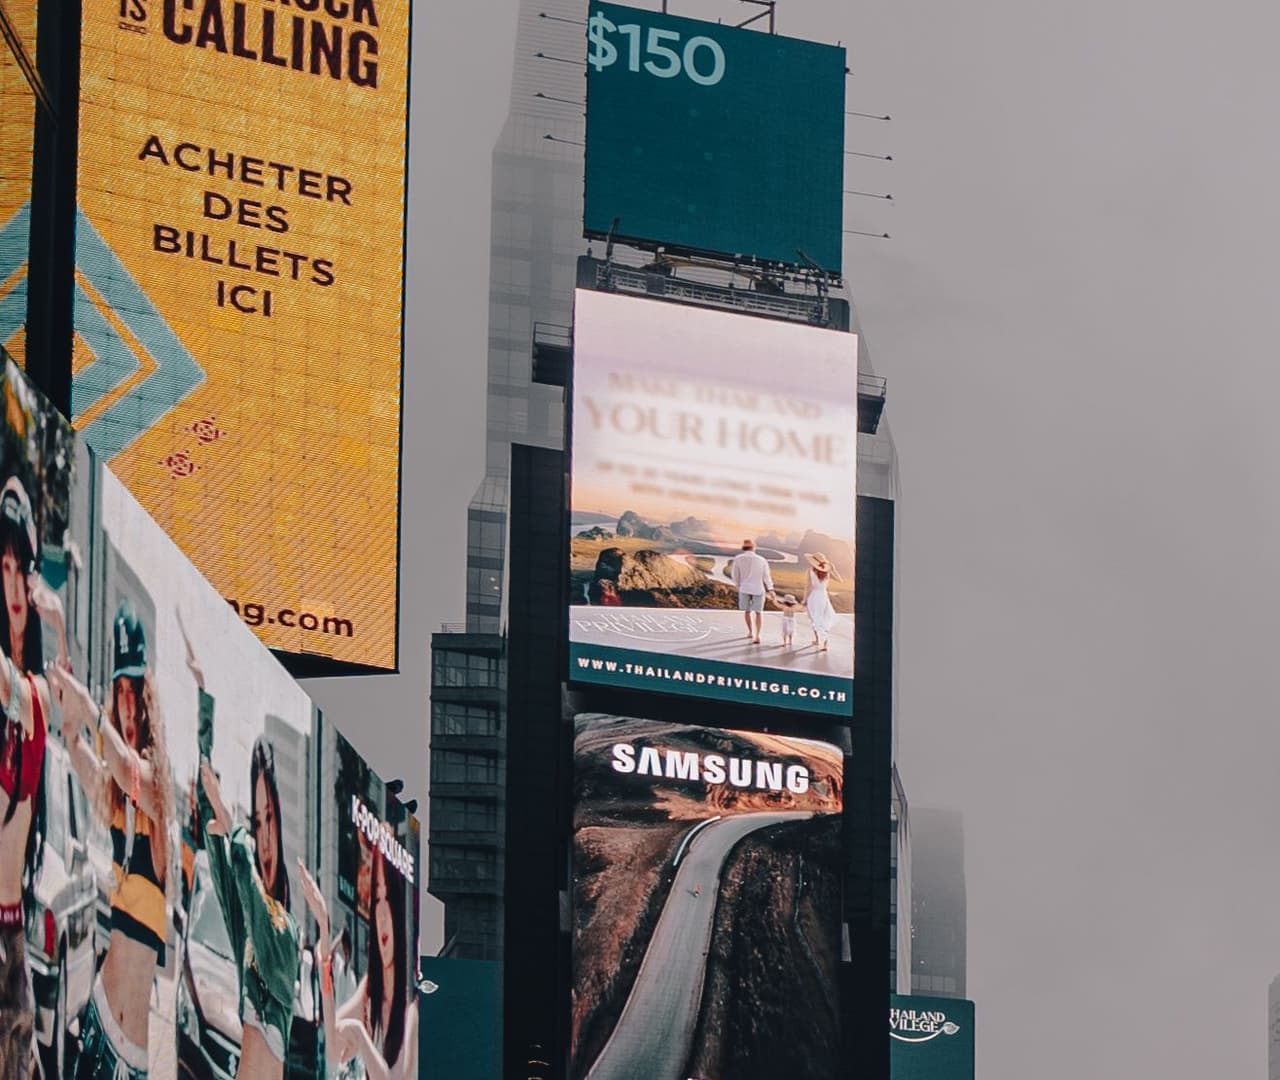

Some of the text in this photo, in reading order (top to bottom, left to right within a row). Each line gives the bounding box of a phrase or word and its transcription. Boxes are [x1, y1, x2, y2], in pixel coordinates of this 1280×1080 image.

[163, 0, 379, 89] CALLING
[588, 11, 727, 87] $150
[138, 134, 352, 205] ACHETER
[202, 190, 289, 234] DES
[152, 223, 335, 287] BILLETS
[216, 280, 273, 317] ICI
[577, 656, 847, 702] WWW.THAILANDPRIVILEGE.CO.TH
[612, 742, 811, 795] SAMSUNG
[889, 1007, 946, 1023] HAILAND
